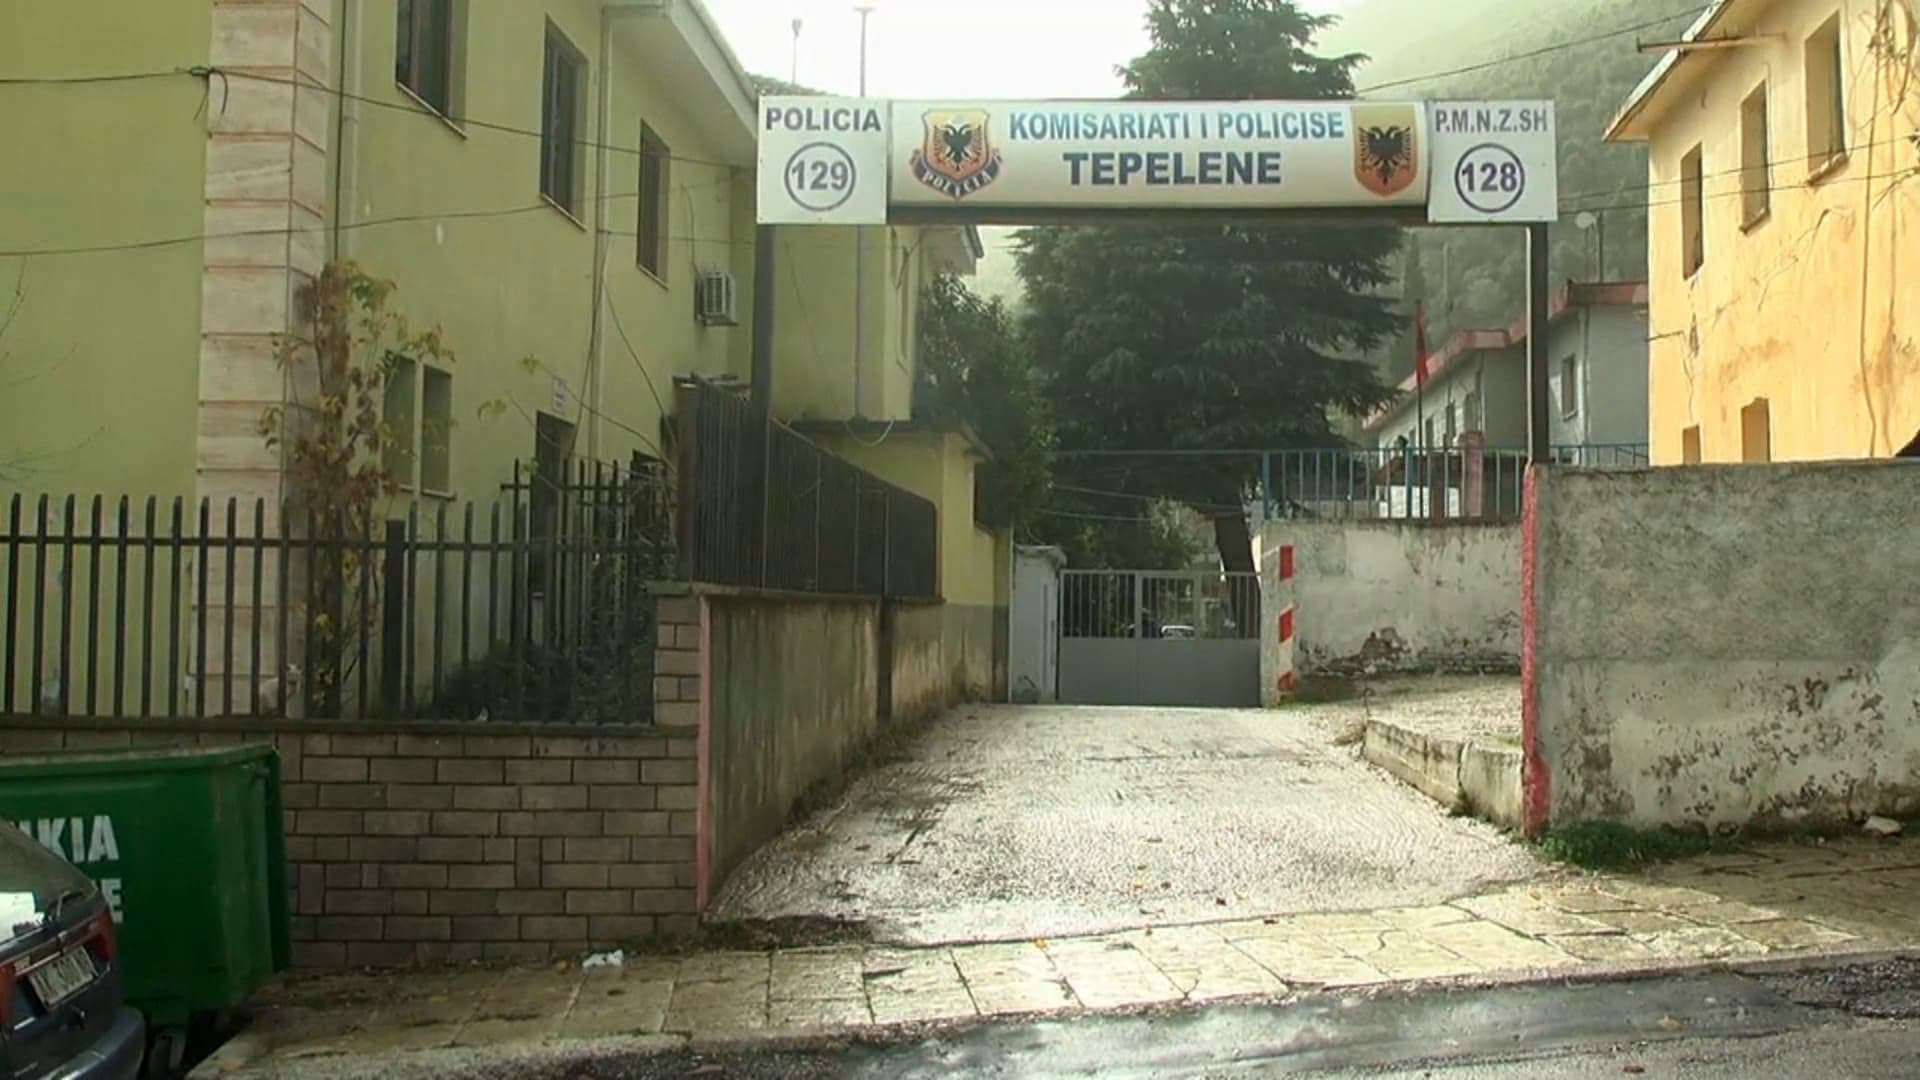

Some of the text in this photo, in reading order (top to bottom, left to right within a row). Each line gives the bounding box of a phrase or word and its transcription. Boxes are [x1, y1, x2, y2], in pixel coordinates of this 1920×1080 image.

[766, 108, 881, 131] POLICIA
[1010, 112, 1345, 140] KOMISARIATI I POLICISE
[1436, 109, 1548, 133] P.M.N.Z.SH
[791, 161, 849, 190] 129
[1063, 152, 1281, 186] TEPELENE
[1461, 162, 1518, 192] 128
[922, 170, 992, 198] POLICIA
